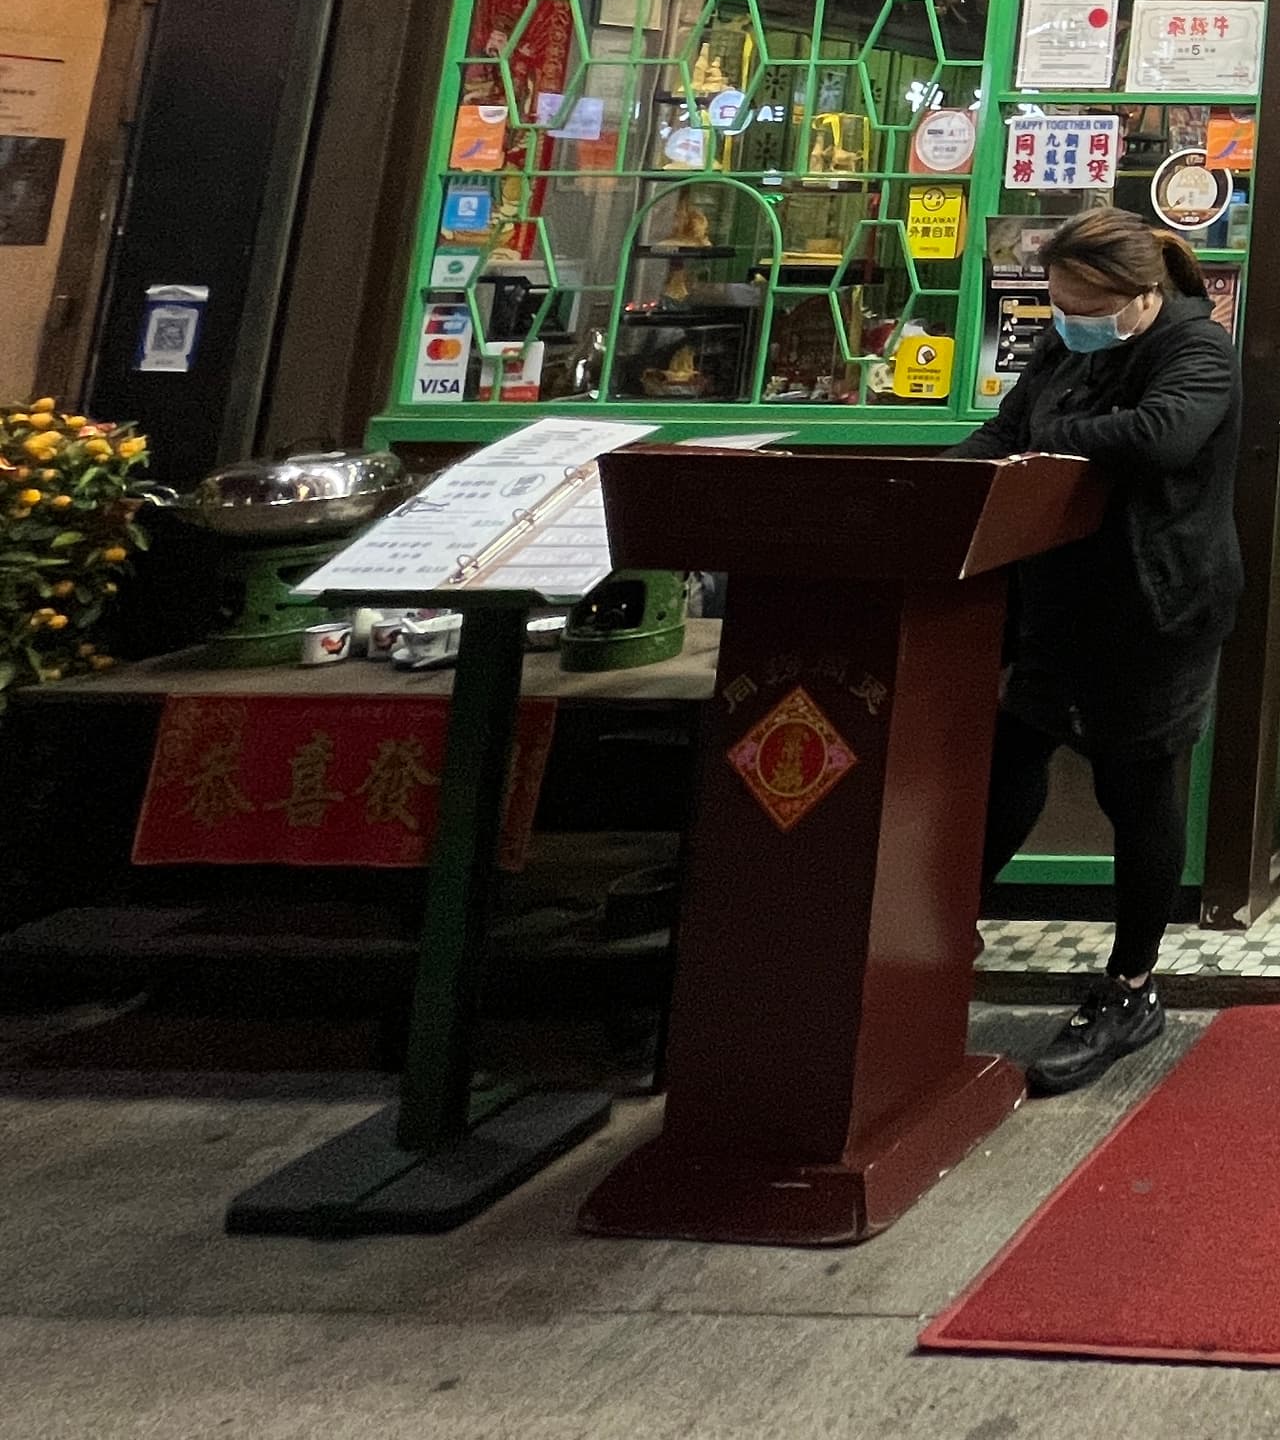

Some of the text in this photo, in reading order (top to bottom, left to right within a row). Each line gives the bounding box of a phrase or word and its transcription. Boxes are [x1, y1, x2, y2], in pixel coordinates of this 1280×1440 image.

[1014, 120, 1114, 131] HAPPY TOGETHER CWB
[420, 378, 460, 395] VISA
